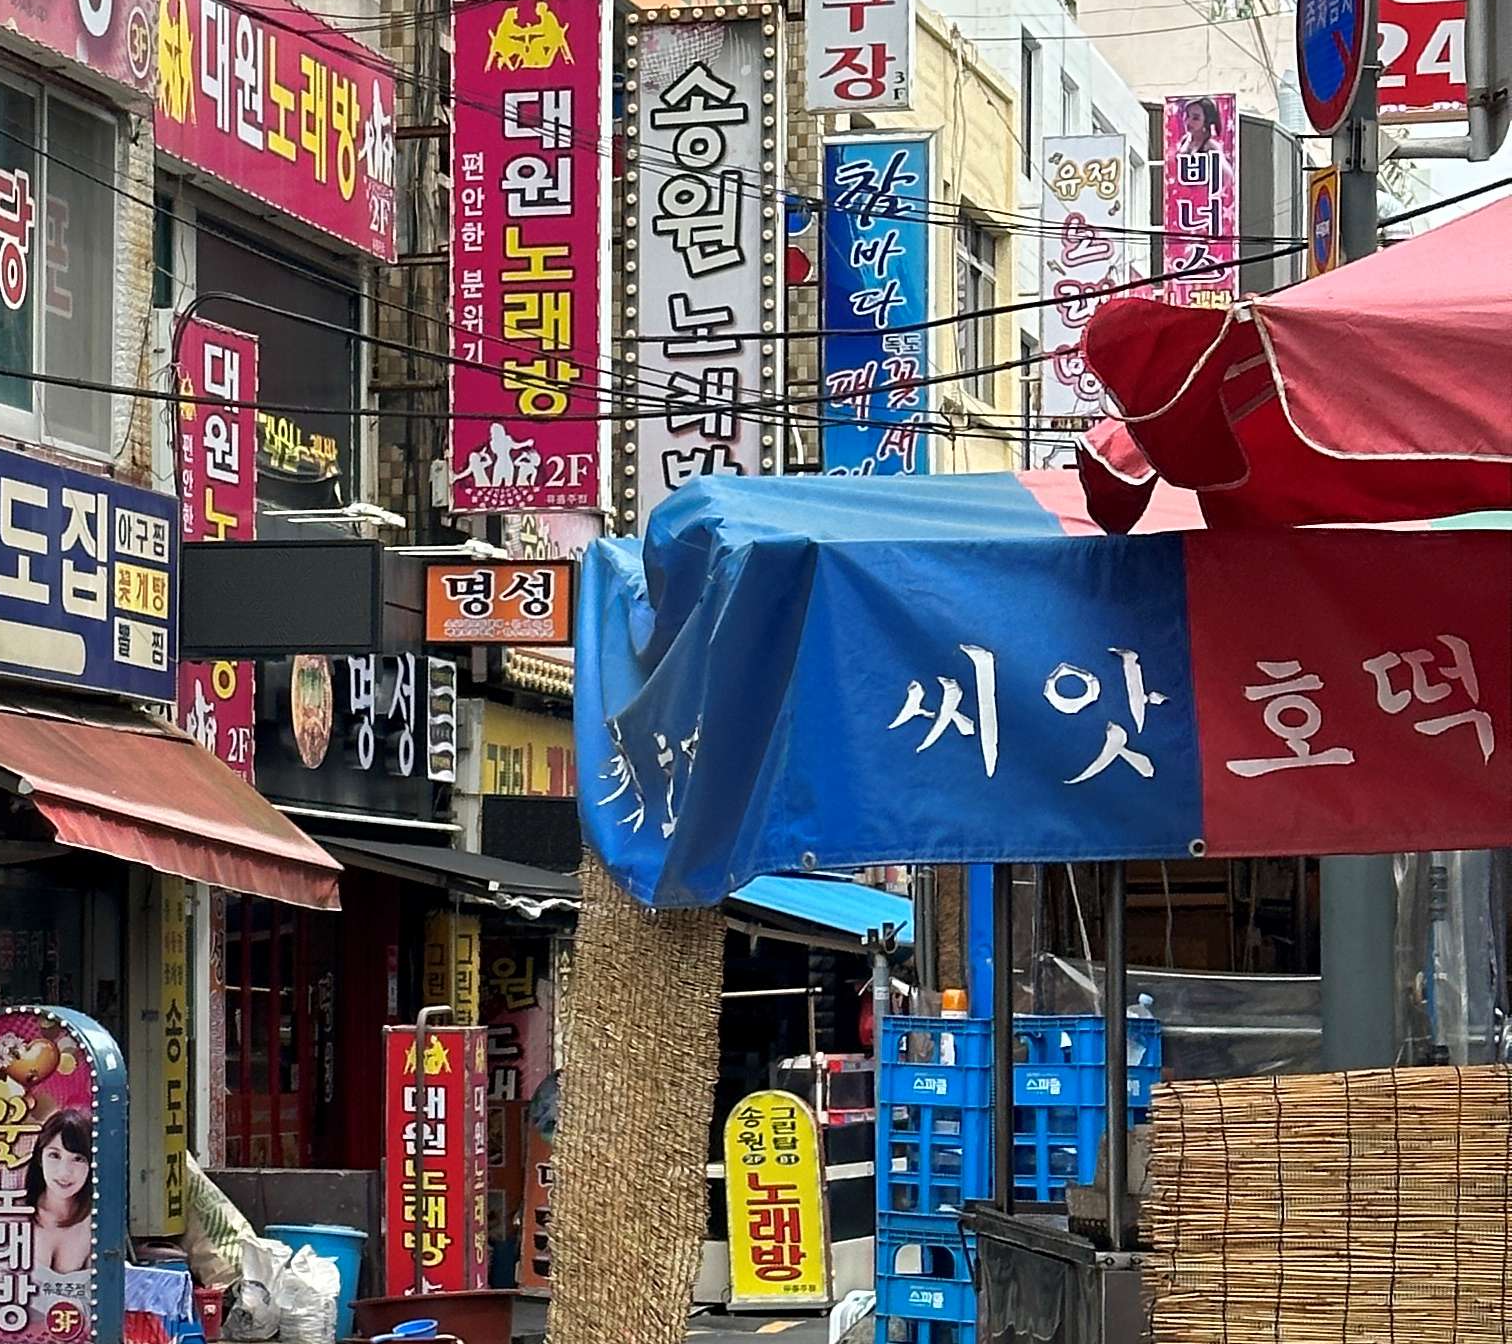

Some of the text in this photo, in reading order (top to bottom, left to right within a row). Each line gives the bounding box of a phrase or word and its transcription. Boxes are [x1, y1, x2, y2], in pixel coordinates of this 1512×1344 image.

[651, 61, 748, 279] 송원
[1055, 158, 1120, 201] 유정
[1172, 151, 1229, 284] 비너스
[459, 152, 484, 364] 편안한 분위기
[882, 333, 923, 355] 독도
[544, 454, 593, 487] 2F
[118, 513, 165, 557] 아구찜
[118, 570, 166, 612] 꽃게탕
[441, 570, 555, 619] 명성
[348, 651, 416, 777] 명성
[889, 634, 1494, 785] 씨앗 호떡
[227, 727, 251, 764] 2F
[165, 999, 184, 1219] 송도집
[737, 1106, 766, 1152] 송원
[771, 1106, 799, 1151] 그린탑
[746, 1172, 807, 1282] 노래방
[50, 1309, 79, 1334] 3F
